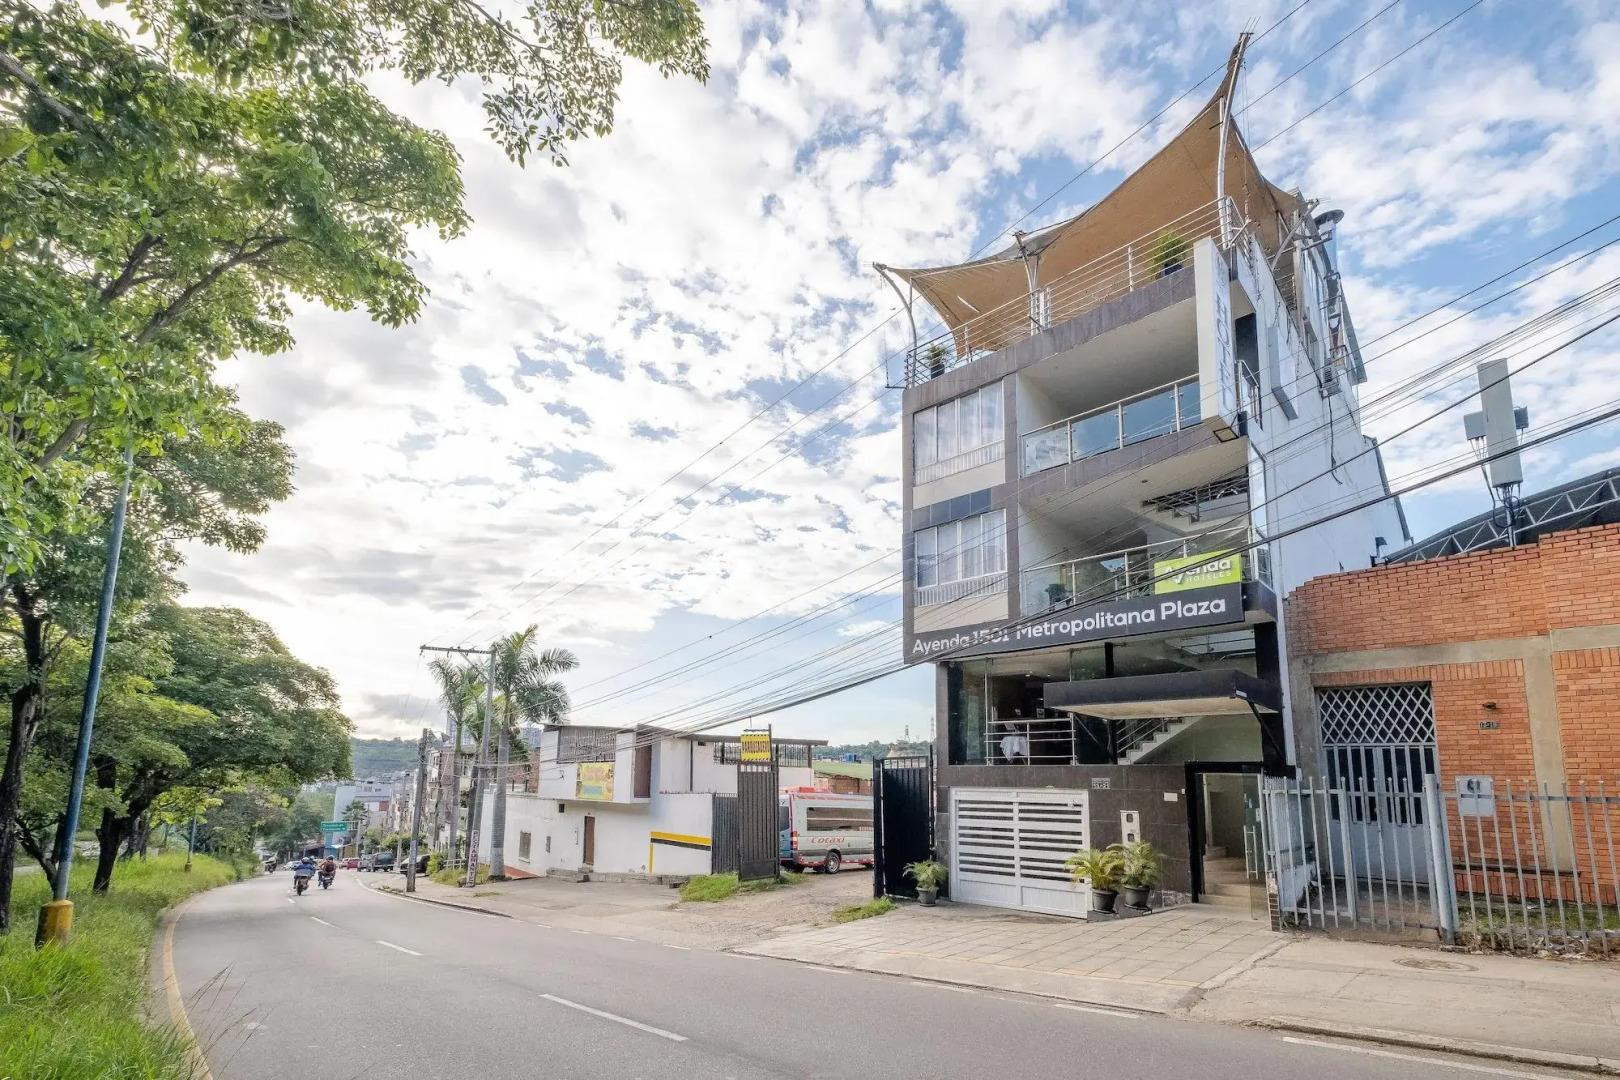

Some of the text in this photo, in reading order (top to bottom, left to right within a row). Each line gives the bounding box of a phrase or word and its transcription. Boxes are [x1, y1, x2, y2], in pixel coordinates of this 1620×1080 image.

[1216, 292, 1233, 412] HOTEL
[1186, 571, 1231, 583] HOTELES
[912, 633, 970, 655] Ayenda
[1016, 608, 1155, 639] Metropolitana
[1161, 599, 1226, 620] Plaza
